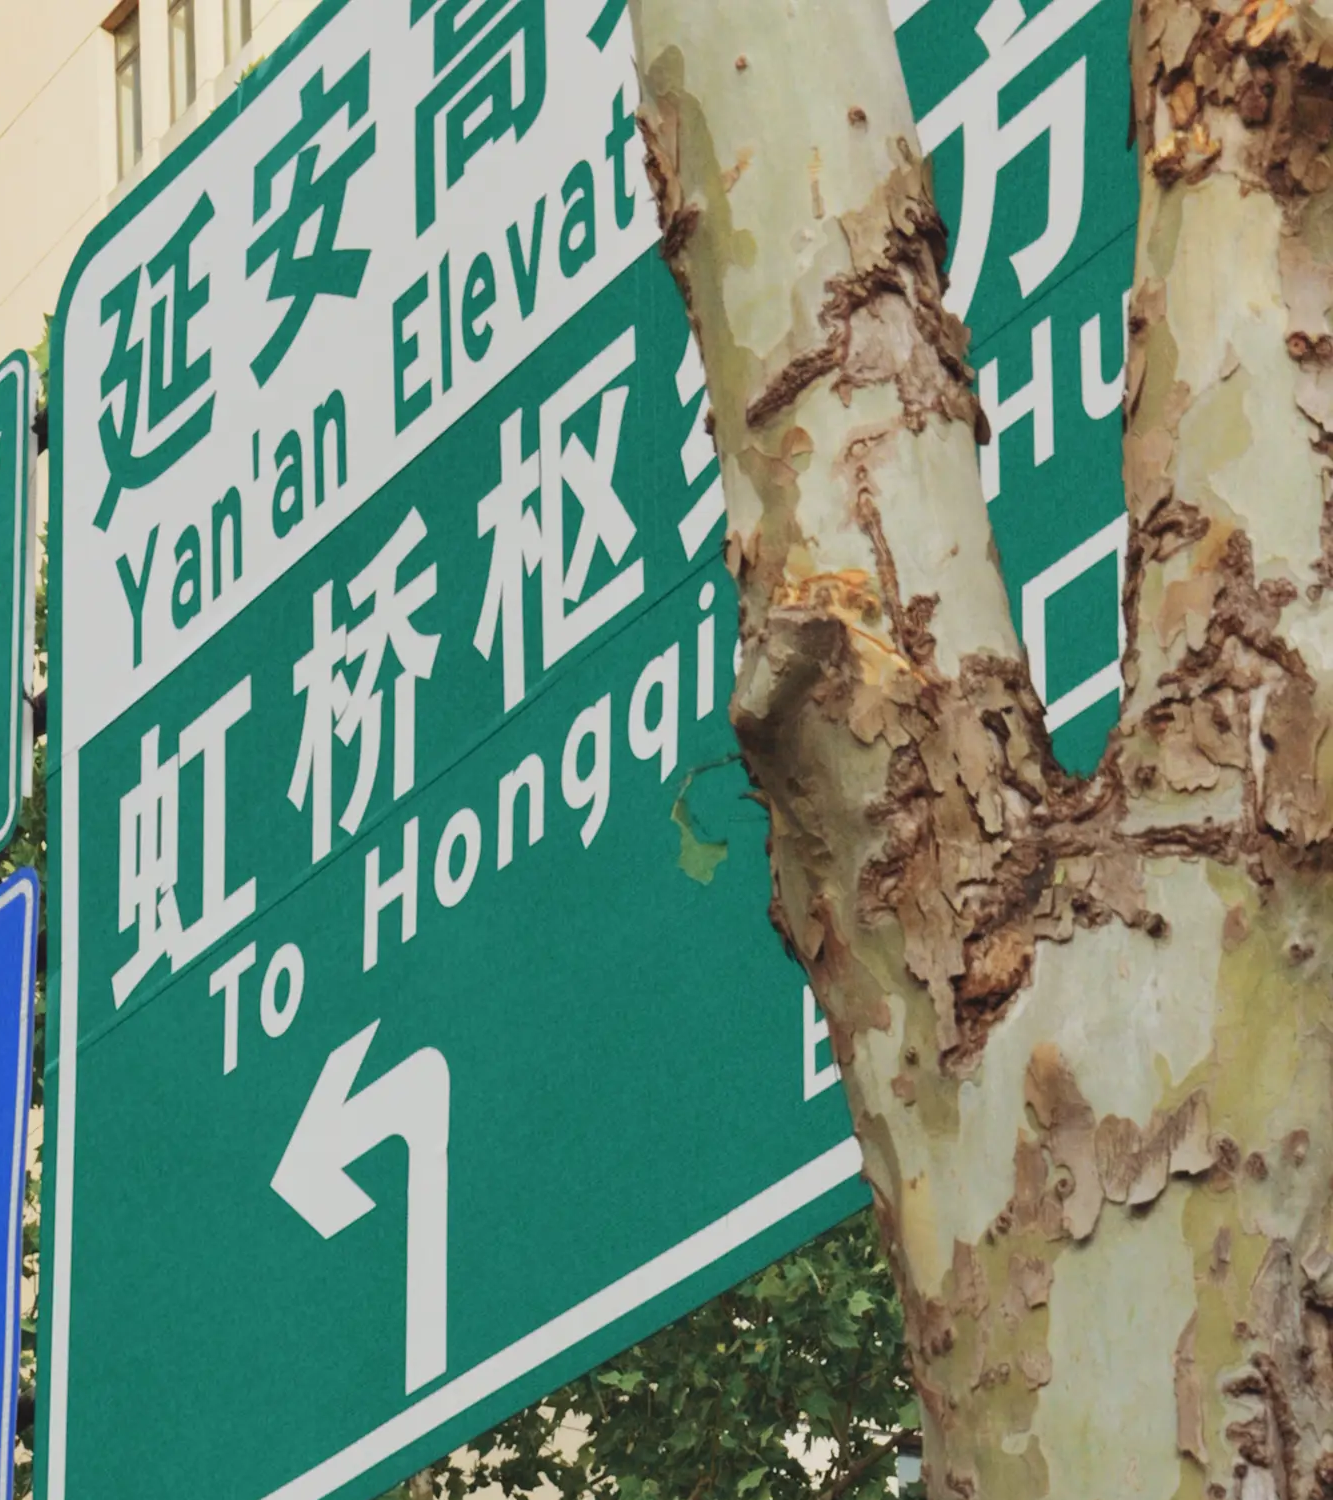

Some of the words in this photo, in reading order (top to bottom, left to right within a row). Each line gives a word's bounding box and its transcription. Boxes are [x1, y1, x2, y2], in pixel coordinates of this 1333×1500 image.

[92, 0, 629, 532] 延安高
[116, 388, 347, 671] Yan'an
[209, 940, 305, 1076] To
[363, 581, 737, 972] Hongqi
